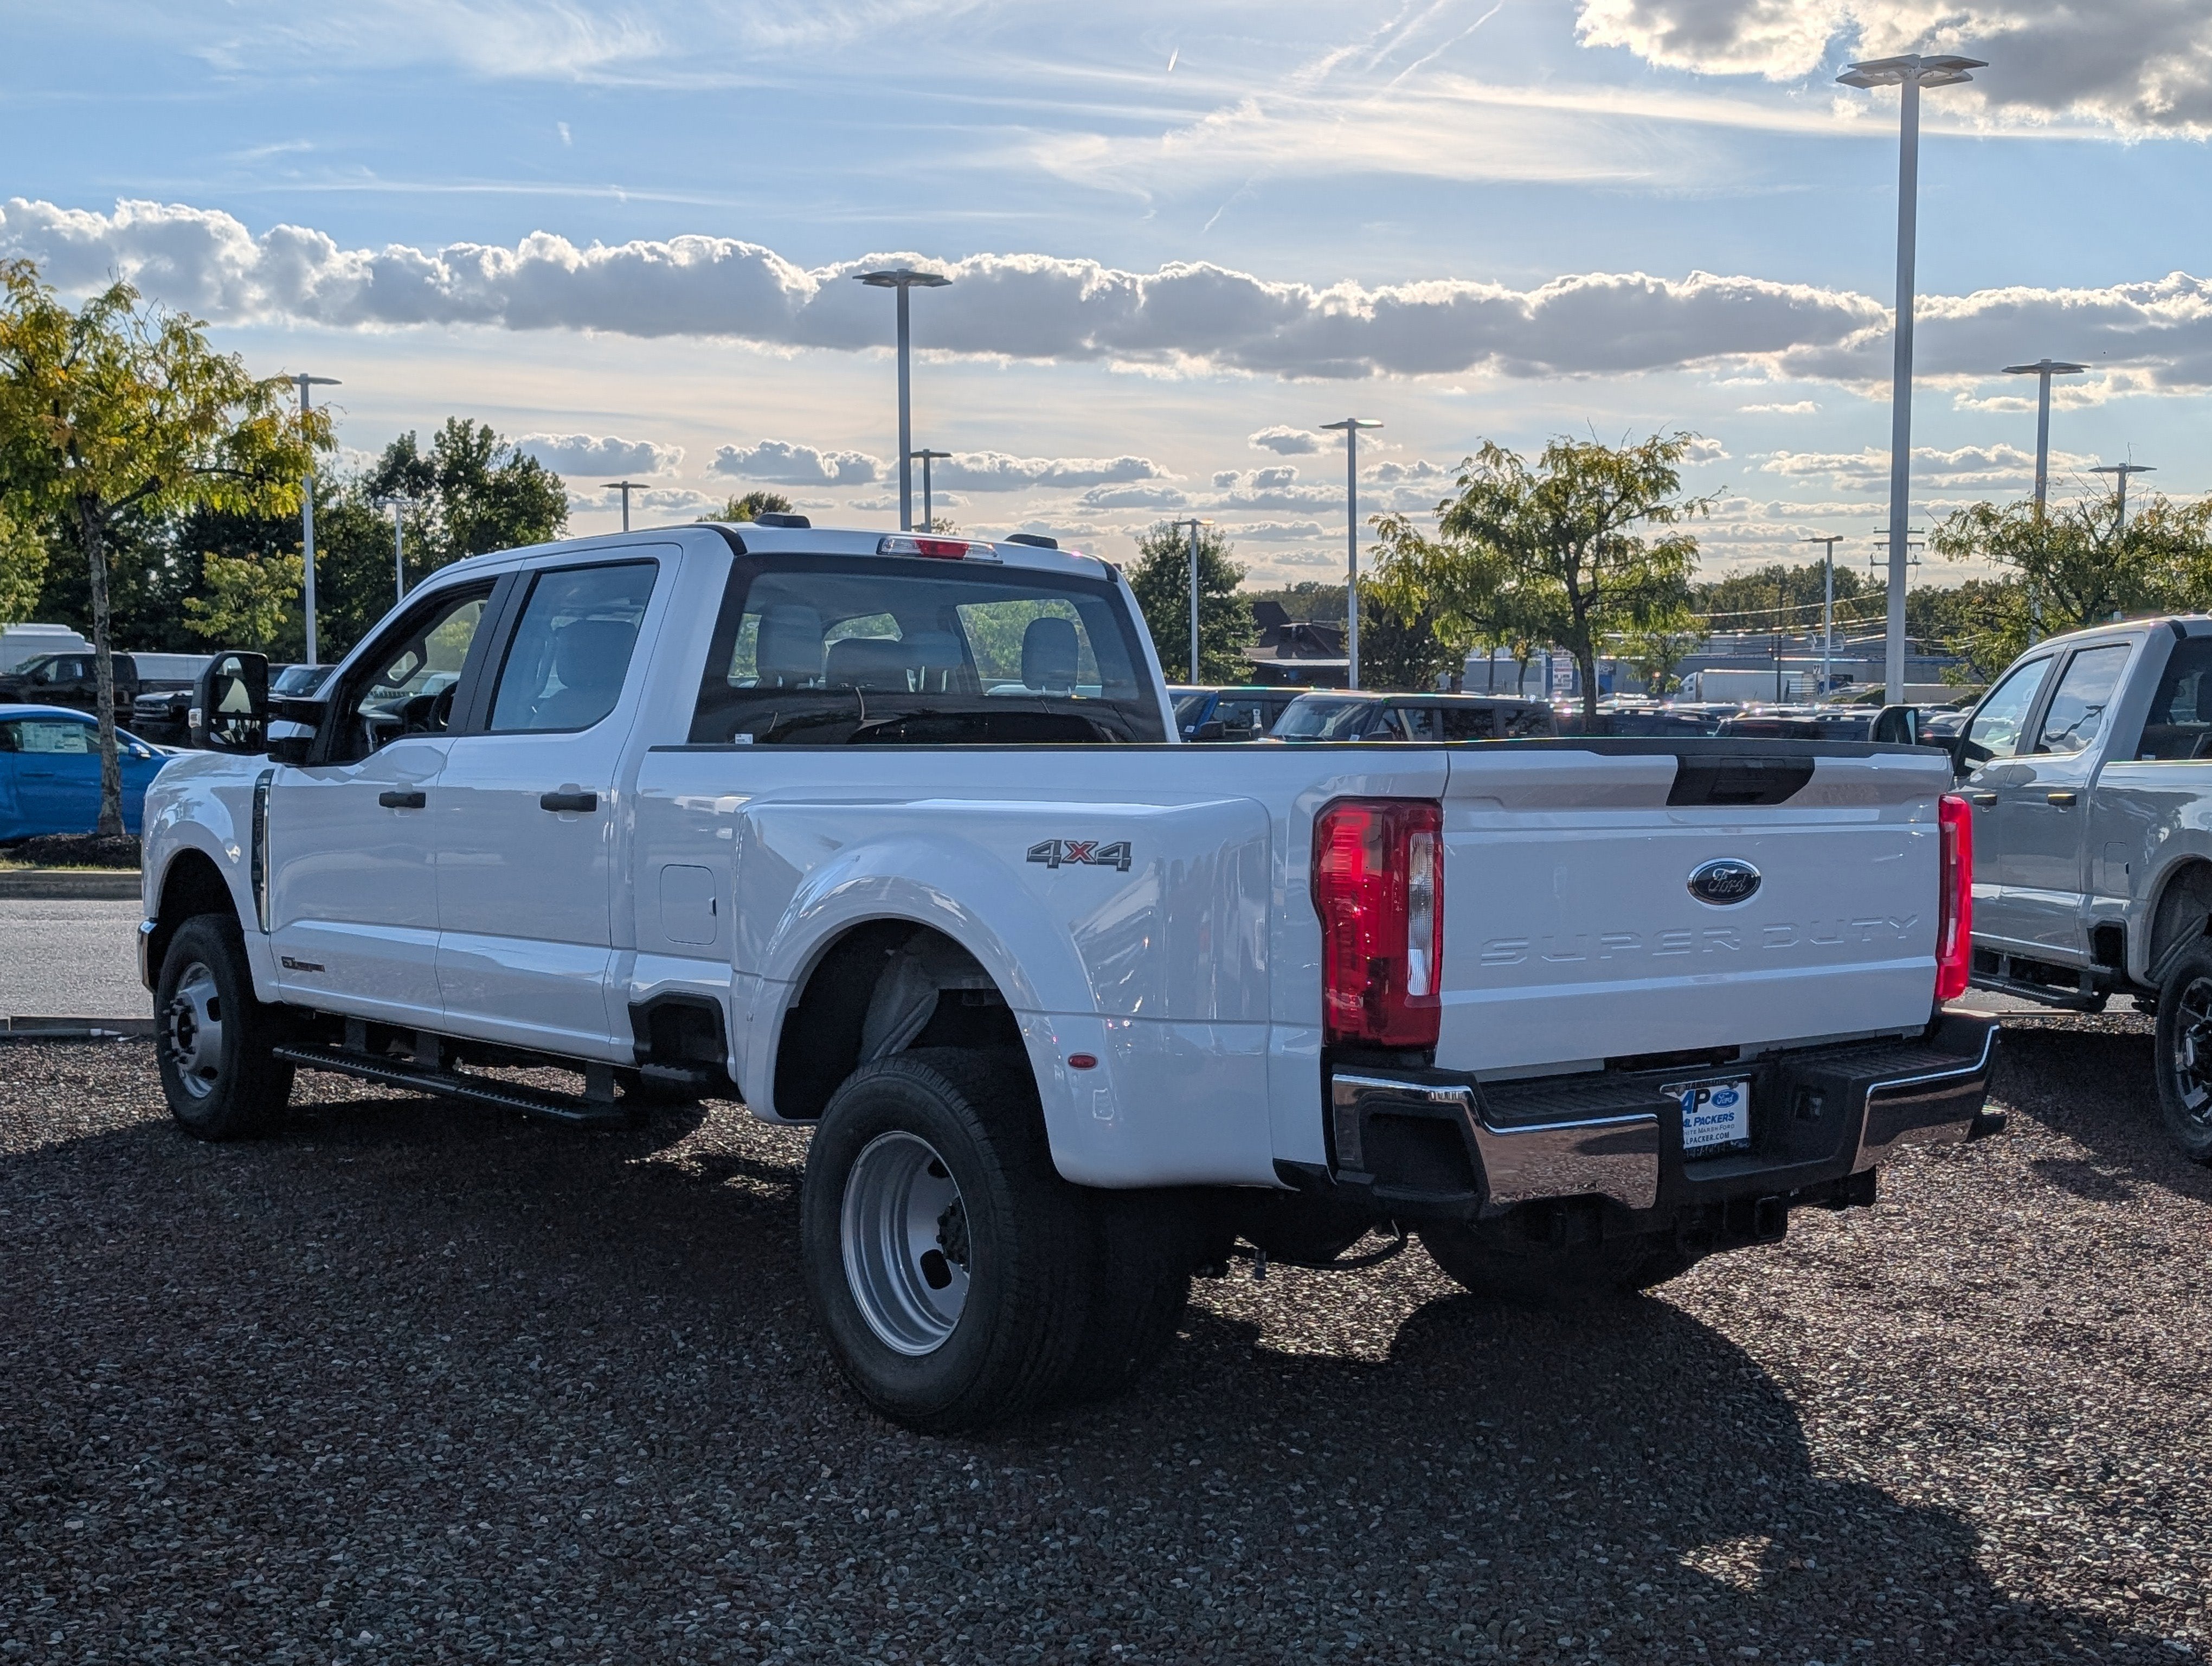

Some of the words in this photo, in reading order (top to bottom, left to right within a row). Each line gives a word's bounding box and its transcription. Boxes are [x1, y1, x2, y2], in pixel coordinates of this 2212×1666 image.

[1708, 868, 1747, 893] Ford
[1480, 925, 1740, 966] SUPER
[1762, 914, 1918, 949] DUTY
